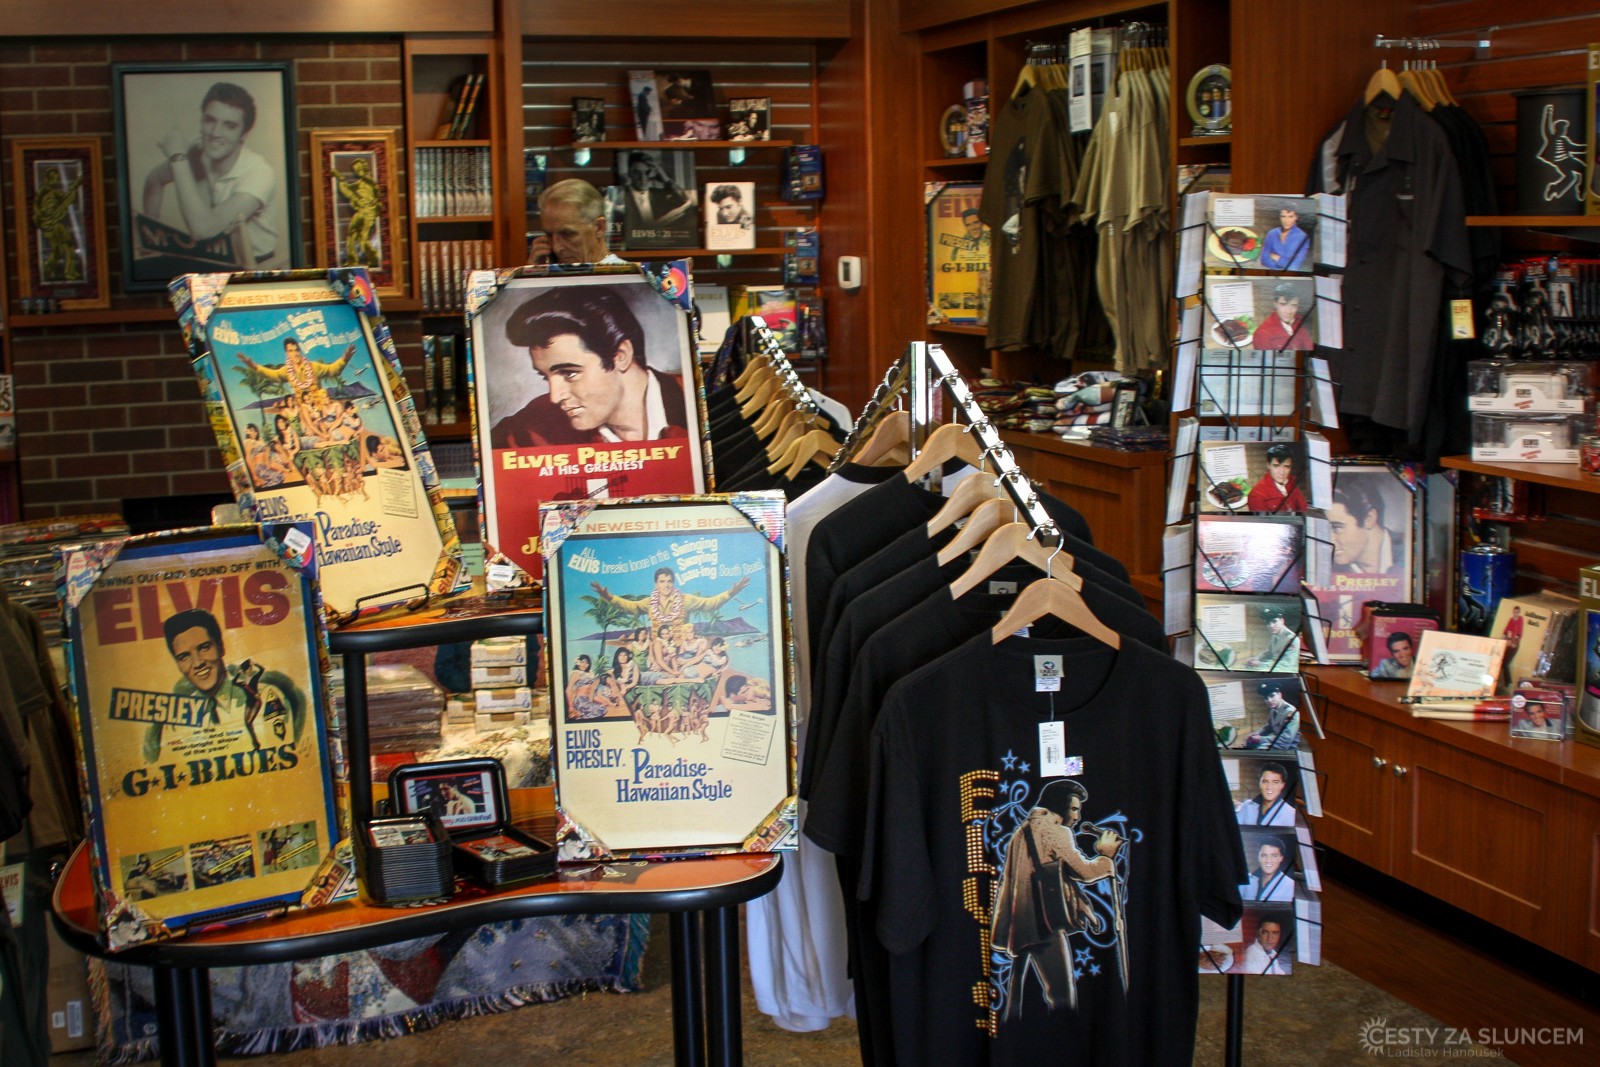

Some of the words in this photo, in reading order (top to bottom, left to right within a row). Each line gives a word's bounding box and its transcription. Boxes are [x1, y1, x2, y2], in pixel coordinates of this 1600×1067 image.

[938, 198, 981, 218] ELV
[502, 450, 570, 470] ELVIS
[577, 446, 683, 465] PRESLEY
[539, 466, 554, 477] AT
[558, 464, 580, 476] HIS
[584, 460, 645, 474] GREATEST
[586, 520, 659, 533] NEWEST!
[665, 519, 692, 529] HIS
[697, 517, 745, 528] BIGGE
[370, 535, 403, 558] Style
[580, 546, 597, 559] ALL
[670, 537, 718, 558] Swinging
[100, 575, 134, 588] SWING
[137, 573, 160, 584] OUT
[163, 570, 186, 581] AND
[189, 565, 228, 578] SOUND
[229, 562, 253, 574] OFF
[255, 559, 281, 570] WITH
[567, 554, 601, 574] ELVIS
[602, 560, 629, 574] breaks
[629, 558, 650, 572] loose
[719, 562, 742, 577] South
[1336, 574, 1399, 588] PRESLEY
[93, 570, 291, 646] ELVIS
[114, 690, 202, 725] PRESLEY
[565, 728, 601, 750] ELVIS
[616, 778, 690, 803] Hawaiian
[692, 778, 733, 801] Style
[0, 873, 19, 889] LVIS
